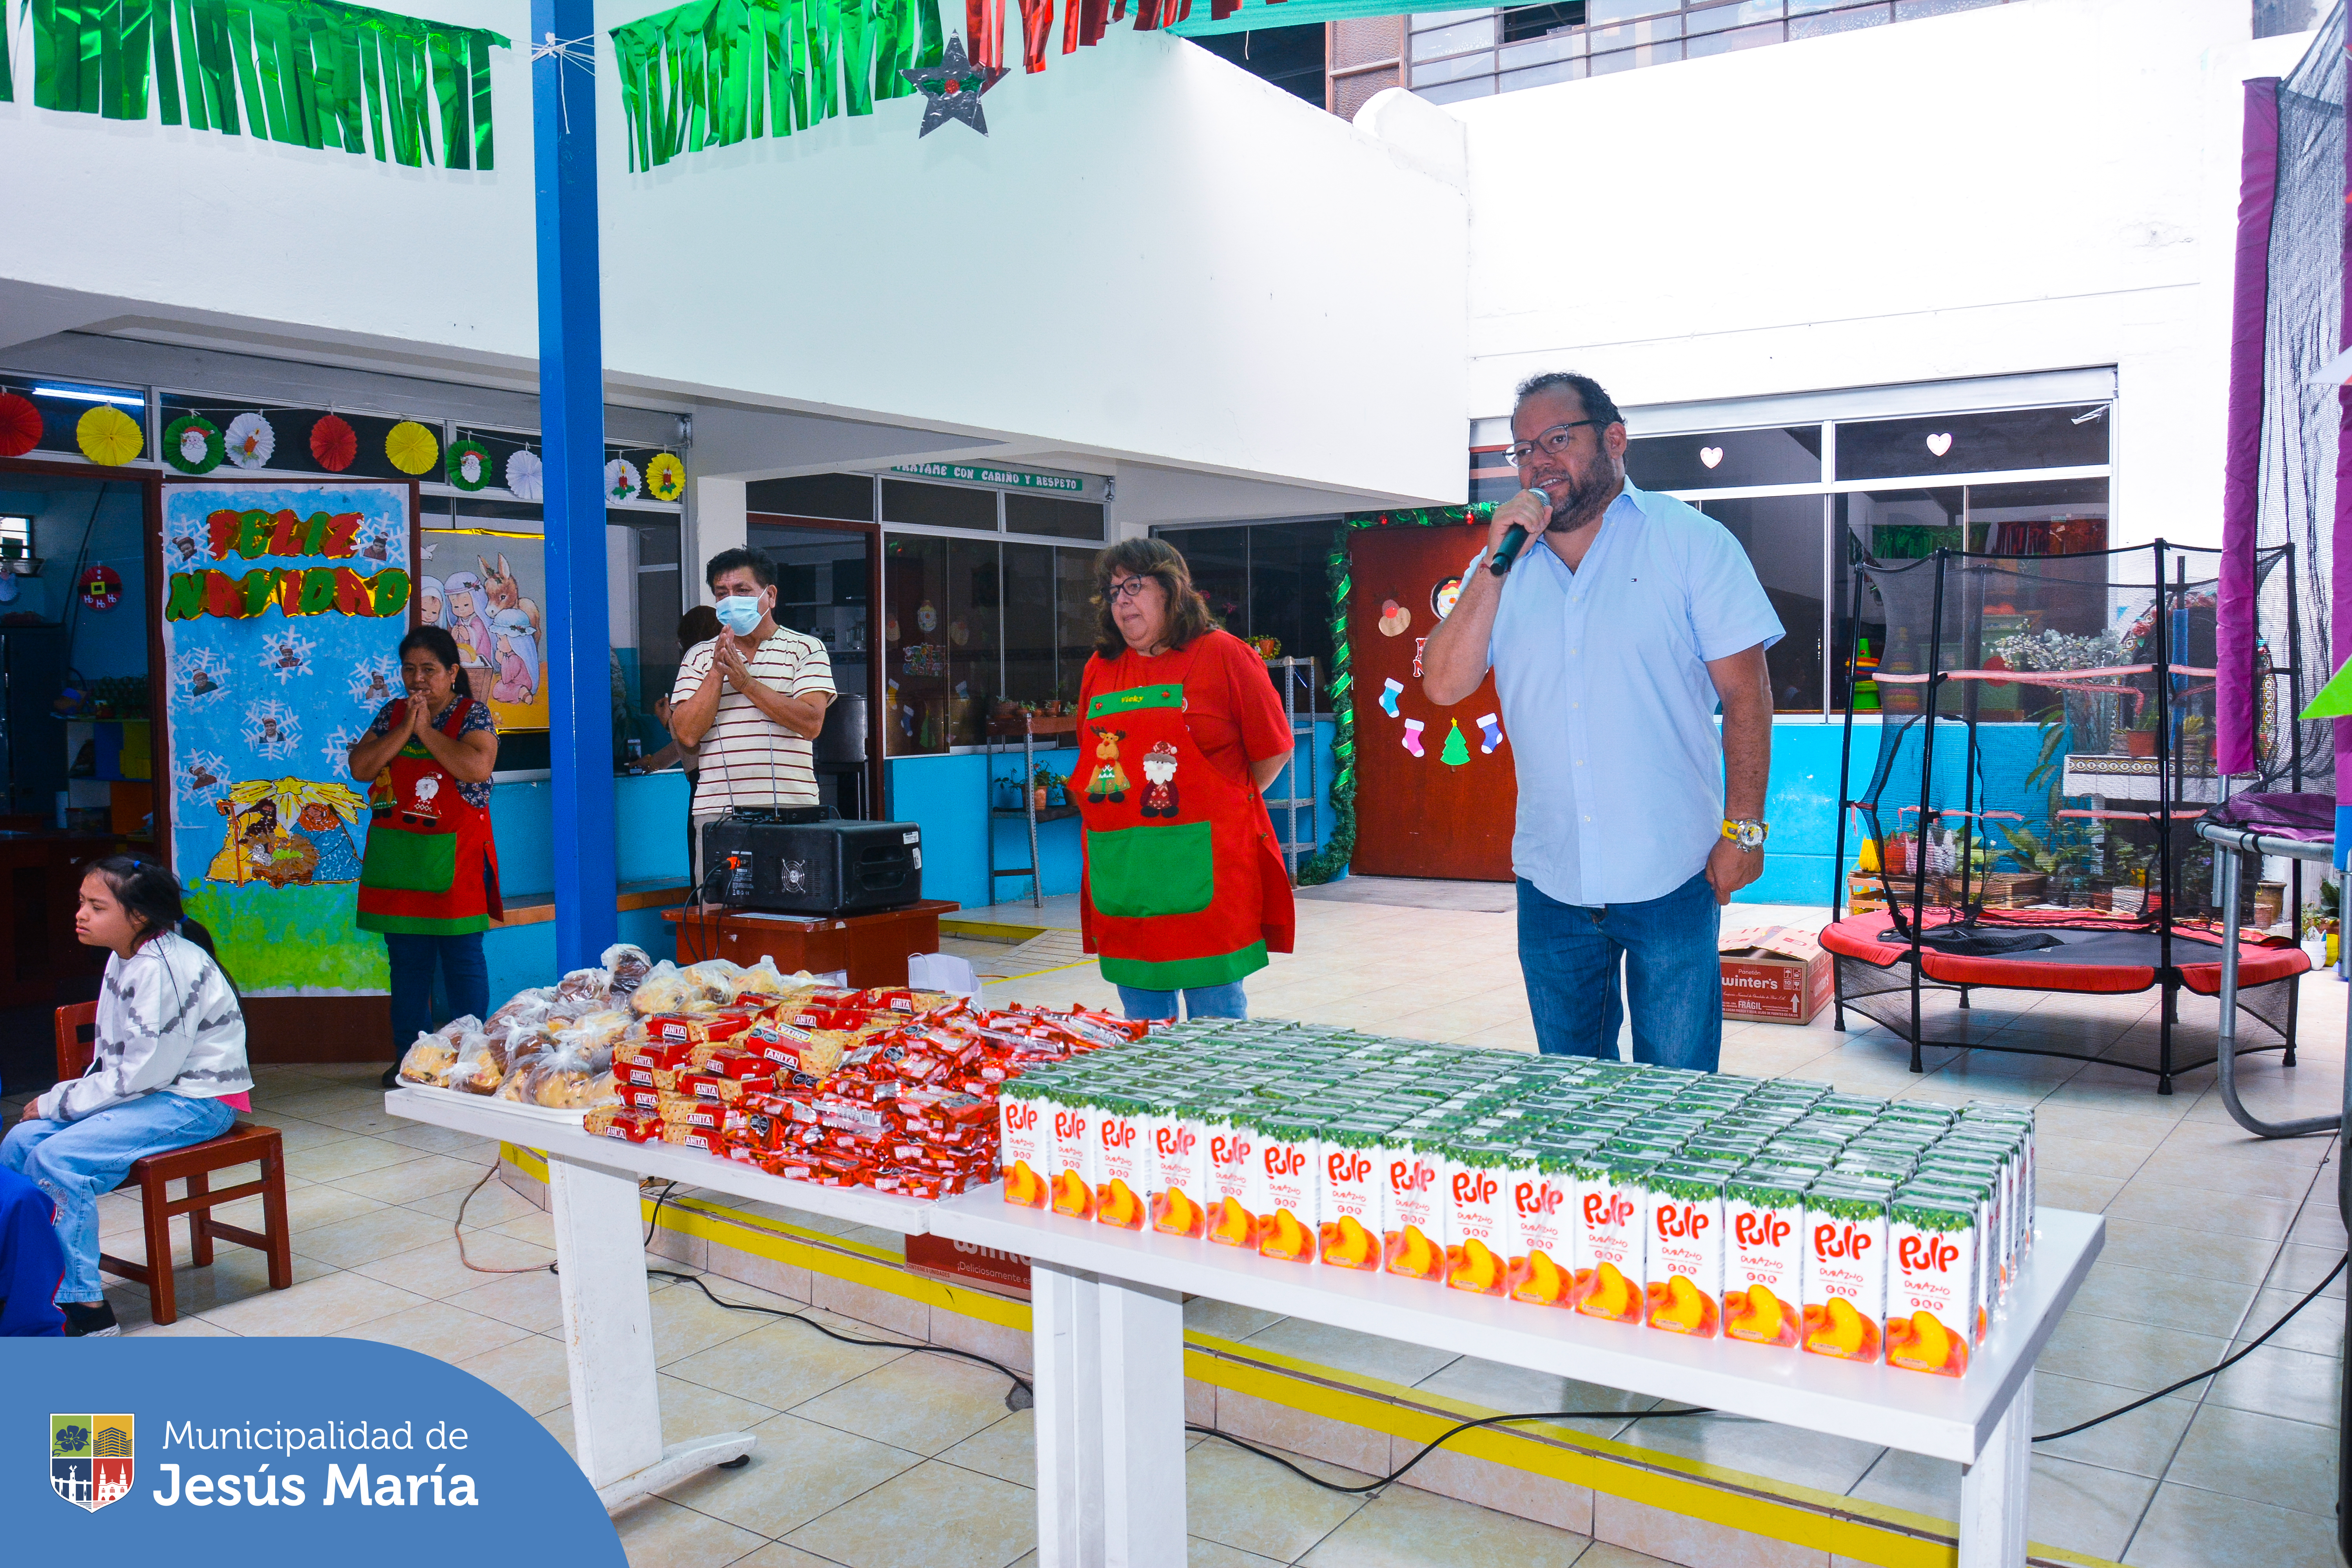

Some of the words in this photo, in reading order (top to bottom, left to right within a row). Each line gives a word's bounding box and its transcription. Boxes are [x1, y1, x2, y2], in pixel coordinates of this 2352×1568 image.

[954, 467, 974, 479] CON
[982, 470, 1019, 483] CARIÑO
[1025, 475, 1030, 484] Y
[1036, 476, 1076, 489] RESPETO
[209, 511, 363, 559] FELIZ
[84, 595, 93, 603] Ho
[107, 594, 116, 603] Ho
[167, 568, 410, 620] NAVIDAD
[96, 600, 105, 608] Ho
[1721, 975, 1778, 989] winter's
[892, 1000, 911, 1008] ANITA
[1738, 999, 1762, 1010] FRÁGIL
[795, 1016, 815, 1025] ANITA
[664, 1025, 685, 1035] ANITA
[779, 1026, 809, 1041] ANITA
[633, 1057, 652, 1067] ANITA
[706, 1060, 722, 1072] ANITA
[766, 1051, 796, 1065] ANITA
[632, 1071, 651, 1081] ANITA
[636, 1094, 657, 1104] ANITA
[695, 1085, 717, 1095] ANITA
[688, 1115, 712, 1125] ANITA
[1006, 1102, 1038, 1134] Pulp
[1055, 1109, 1086, 1142] Pulp
[606, 1127, 625, 1137] ANITA
[1102, 1118, 1136, 1151] Pulp
[686, 1136, 707, 1147] ANITA
[1156, 1125, 1196, 1159] Pulp
[1211, 1134, 1251, 1168] Pulp
[1265, 1143, 1306, 1180] Pulp
[1328, 1150, 1372, 1186] Pulp
[1390, 1159, 1435, 1195] Pulp
[1453, 1169, 1498, 1208] Pulp
[1515, 1179, 1563, 1218] Pulp
[1584, 1191, 1634, 1230] Pulp
[1657, 1202, 1709, 1242] Pulp
[1736, 1210, 1791, 1250] Pulp
[1814, 1221, 1871, 1263] Pulp
[1899, 1233, 1959, 1275] Pulp
[906, 1263, 926, 1273] CONTIENE
[929, 1268, 951, 1278] UNIDADES
[957, 1261, 1021, 1283] ¡Deliciosamente
